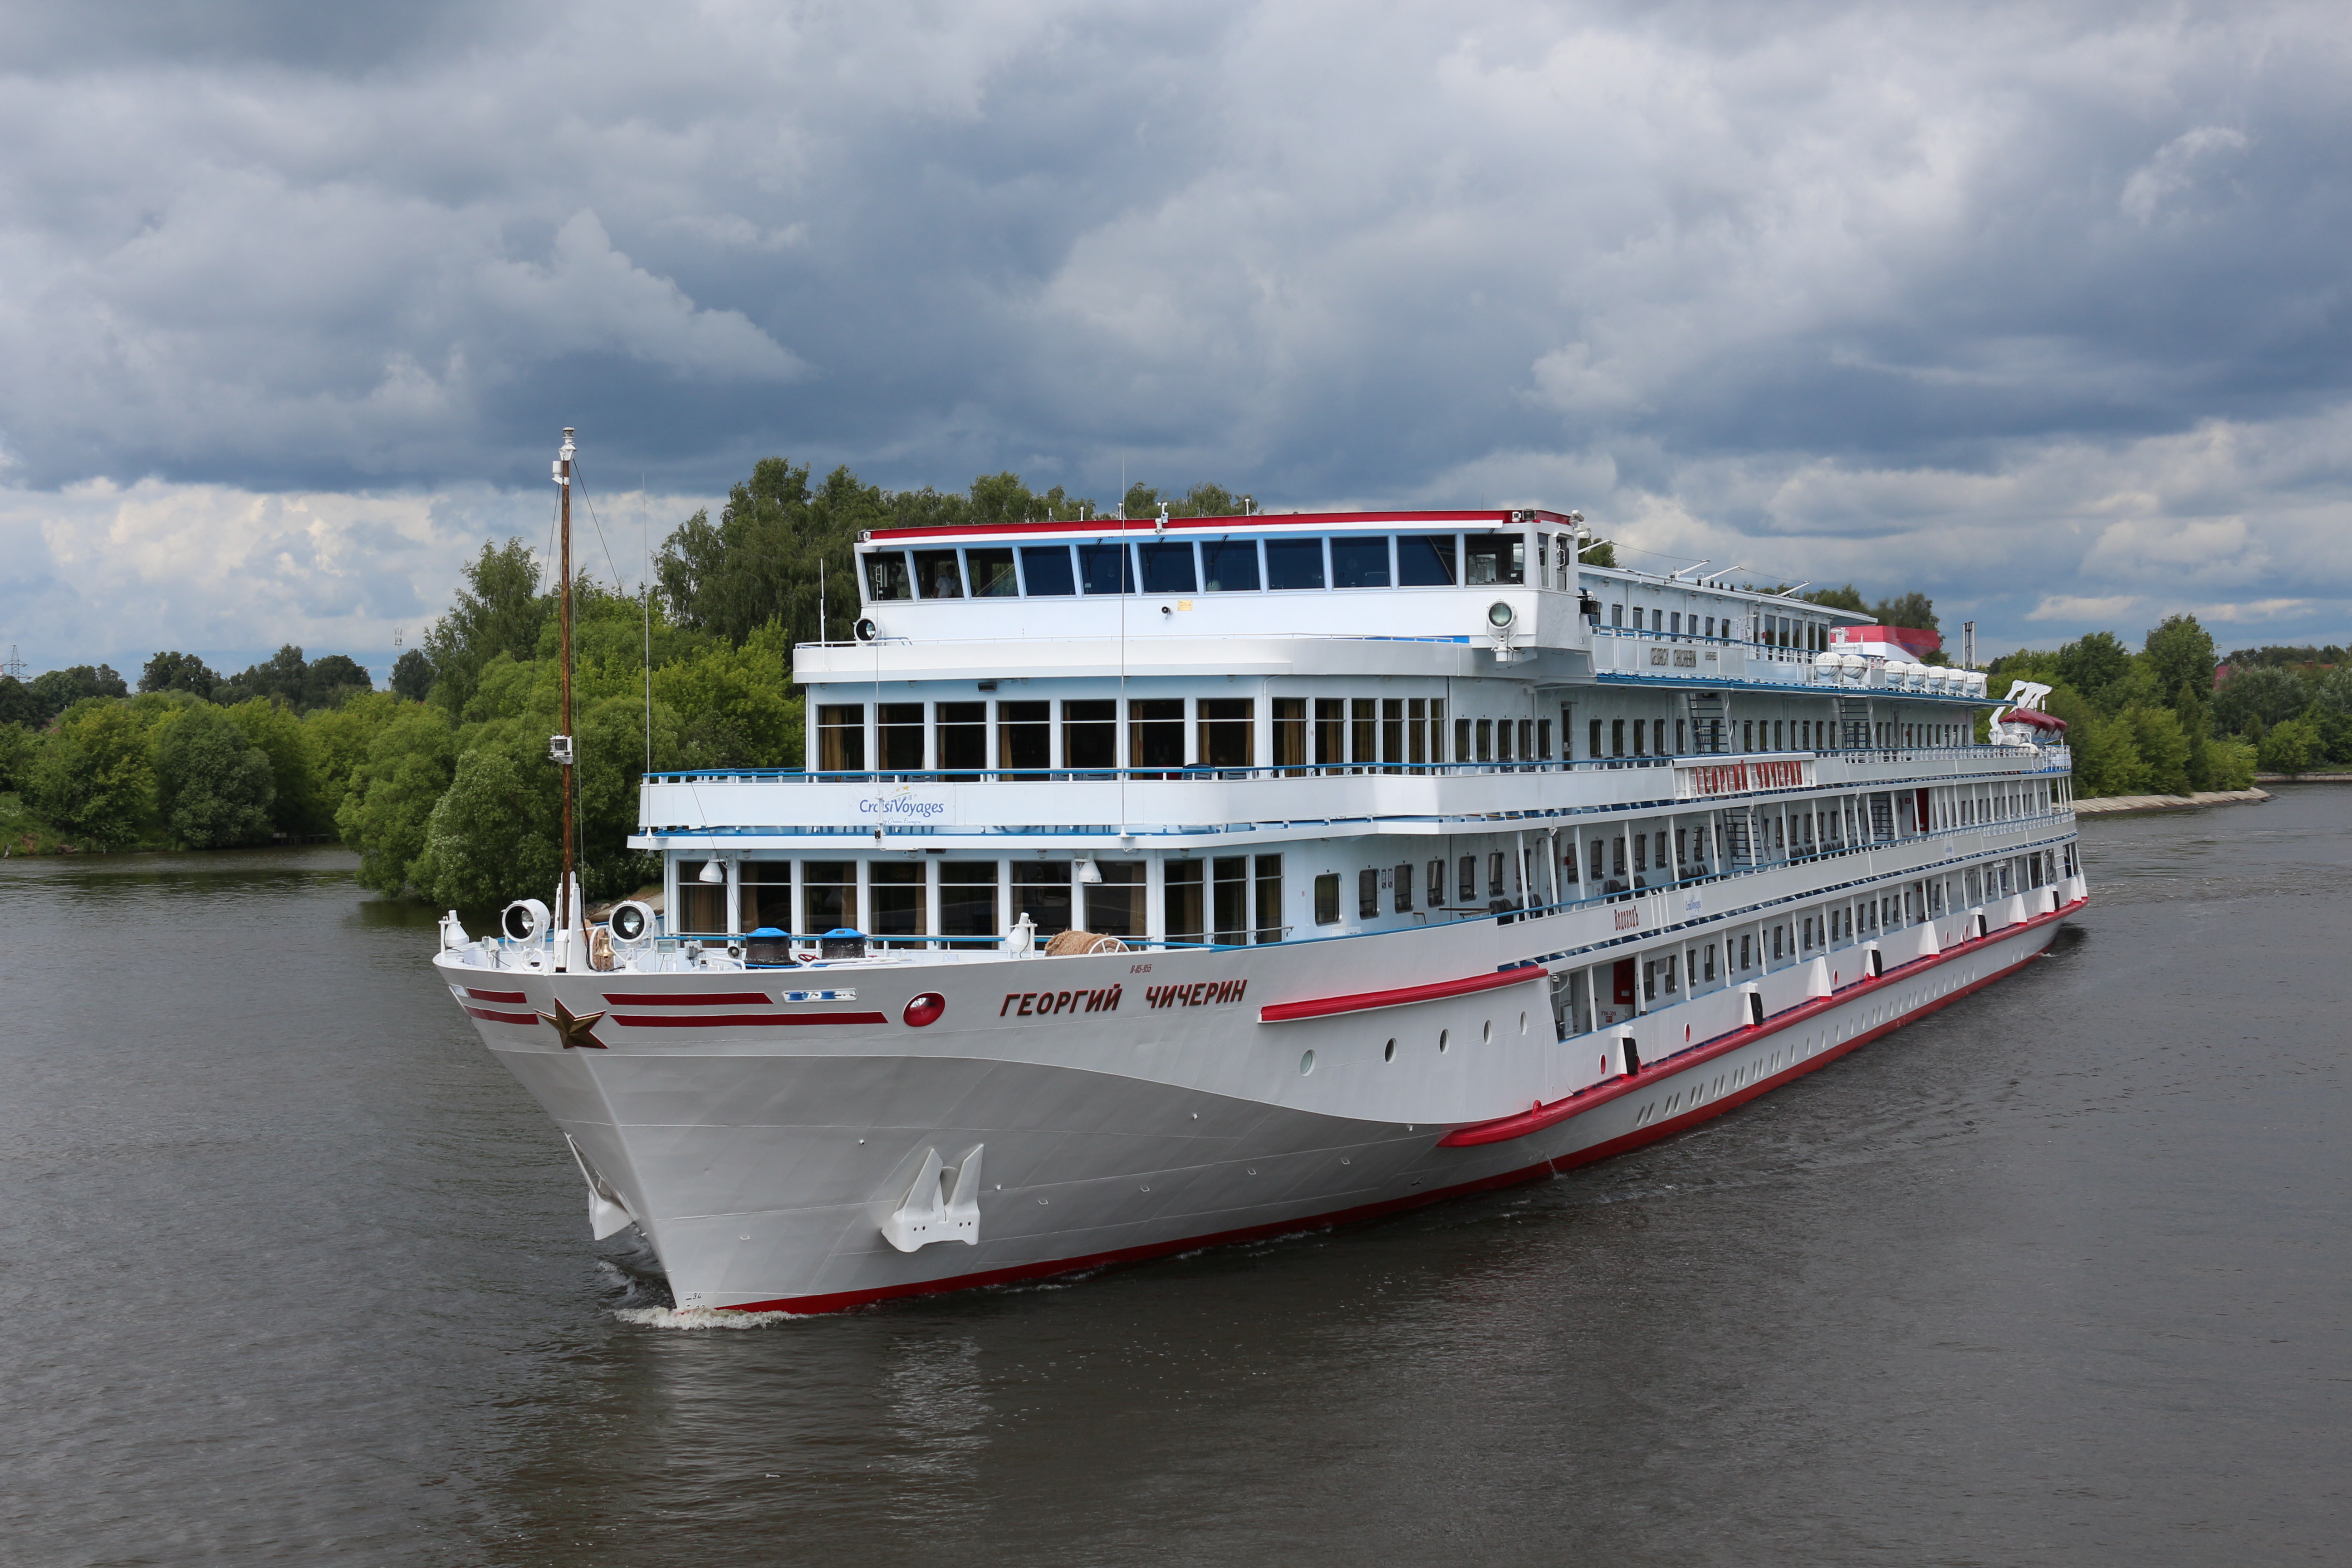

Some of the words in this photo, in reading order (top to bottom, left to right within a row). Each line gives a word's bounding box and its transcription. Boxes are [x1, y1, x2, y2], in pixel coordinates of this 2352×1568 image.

[1651, 647, 1670, 666] GEORGY
[1000, 983, 1123, 1016] ГЕОРГИЙ
[1146, 979, 1248, 1008] ЧИЧЕРИН
